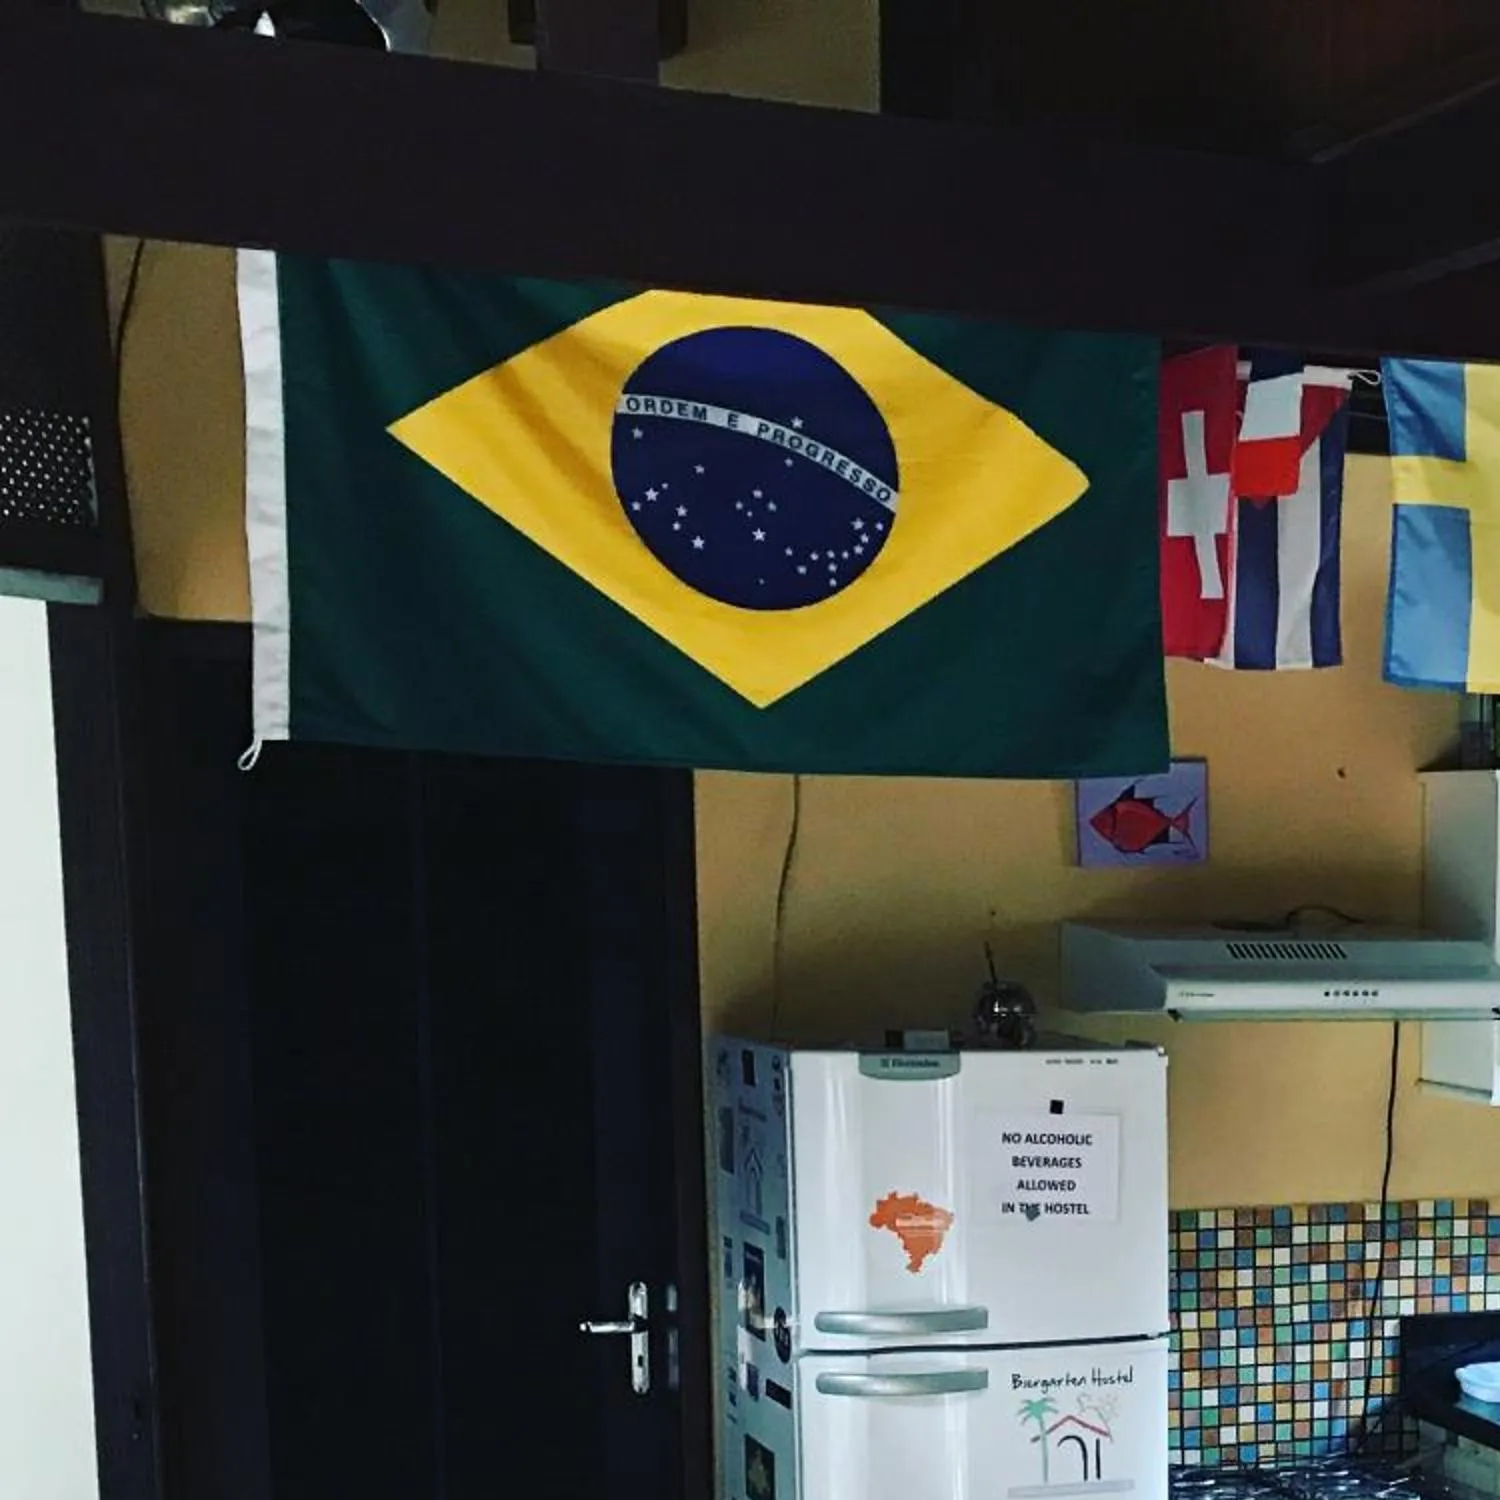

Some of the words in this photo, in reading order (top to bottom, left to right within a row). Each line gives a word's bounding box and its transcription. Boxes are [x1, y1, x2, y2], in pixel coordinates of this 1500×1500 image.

[625, 396, 708, 422] ORDEM
[727, 413, 740, 430] E
[757, 422, 893, 503] PROGRESSO
[1001, 1132, 1022, 1145] NO
[1024, 1132, 1093, 1146] ALCOHOLIC
[1011, 1156, 1083, 1169] BEVERAGES
[1016, 1179, 1077, 1192] ALLOWED
[1001, 1203, 1016, 1214] IN
[1044, 1203, 1091, 1215] HOSTEL
[1091, 1364, 1134, 1387] Hostel
